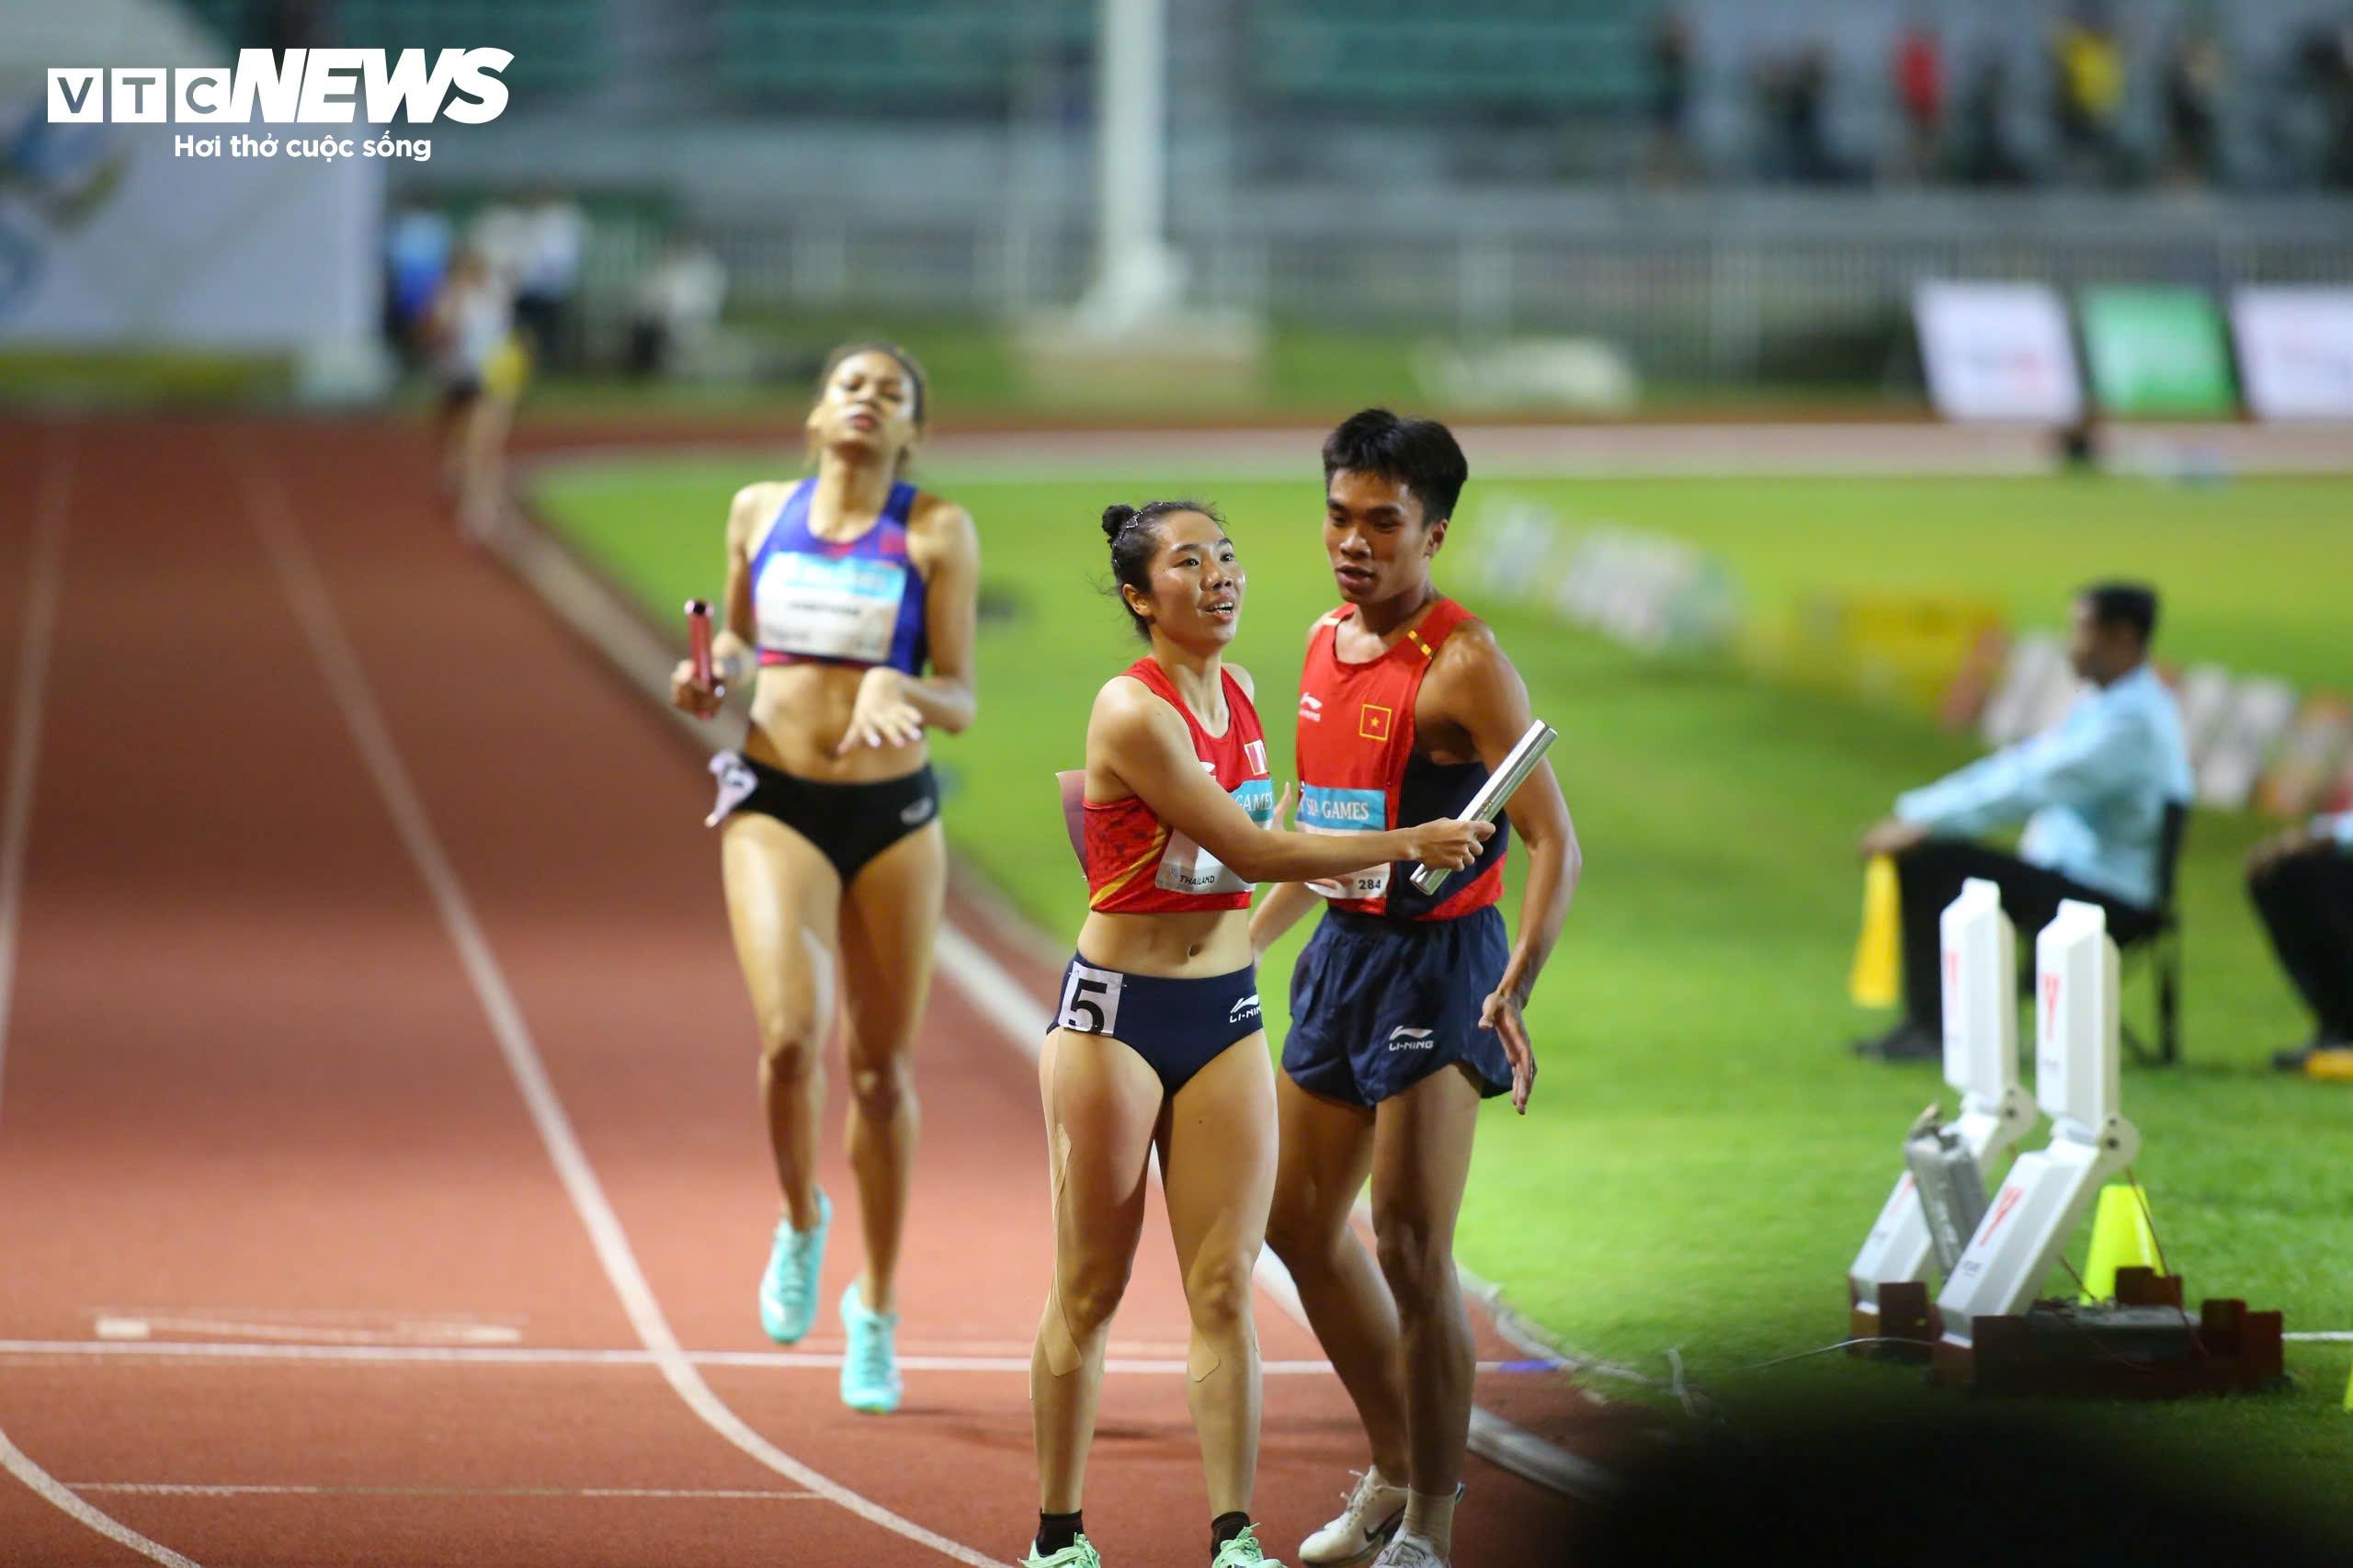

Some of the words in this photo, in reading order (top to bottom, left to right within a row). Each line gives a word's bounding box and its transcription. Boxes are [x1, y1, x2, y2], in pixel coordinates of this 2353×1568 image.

[1322, 801, 1369, 821] GAMES
[1179, 874, 1215, 885] THAILAND
[1358, 878, 1381, 890] 284
[1069, 977, 1108, 1036] 5
[1229, 1005, 1261, 1023] LI-NIN
[1389, 1040, 1434, 1051] LI-NING
